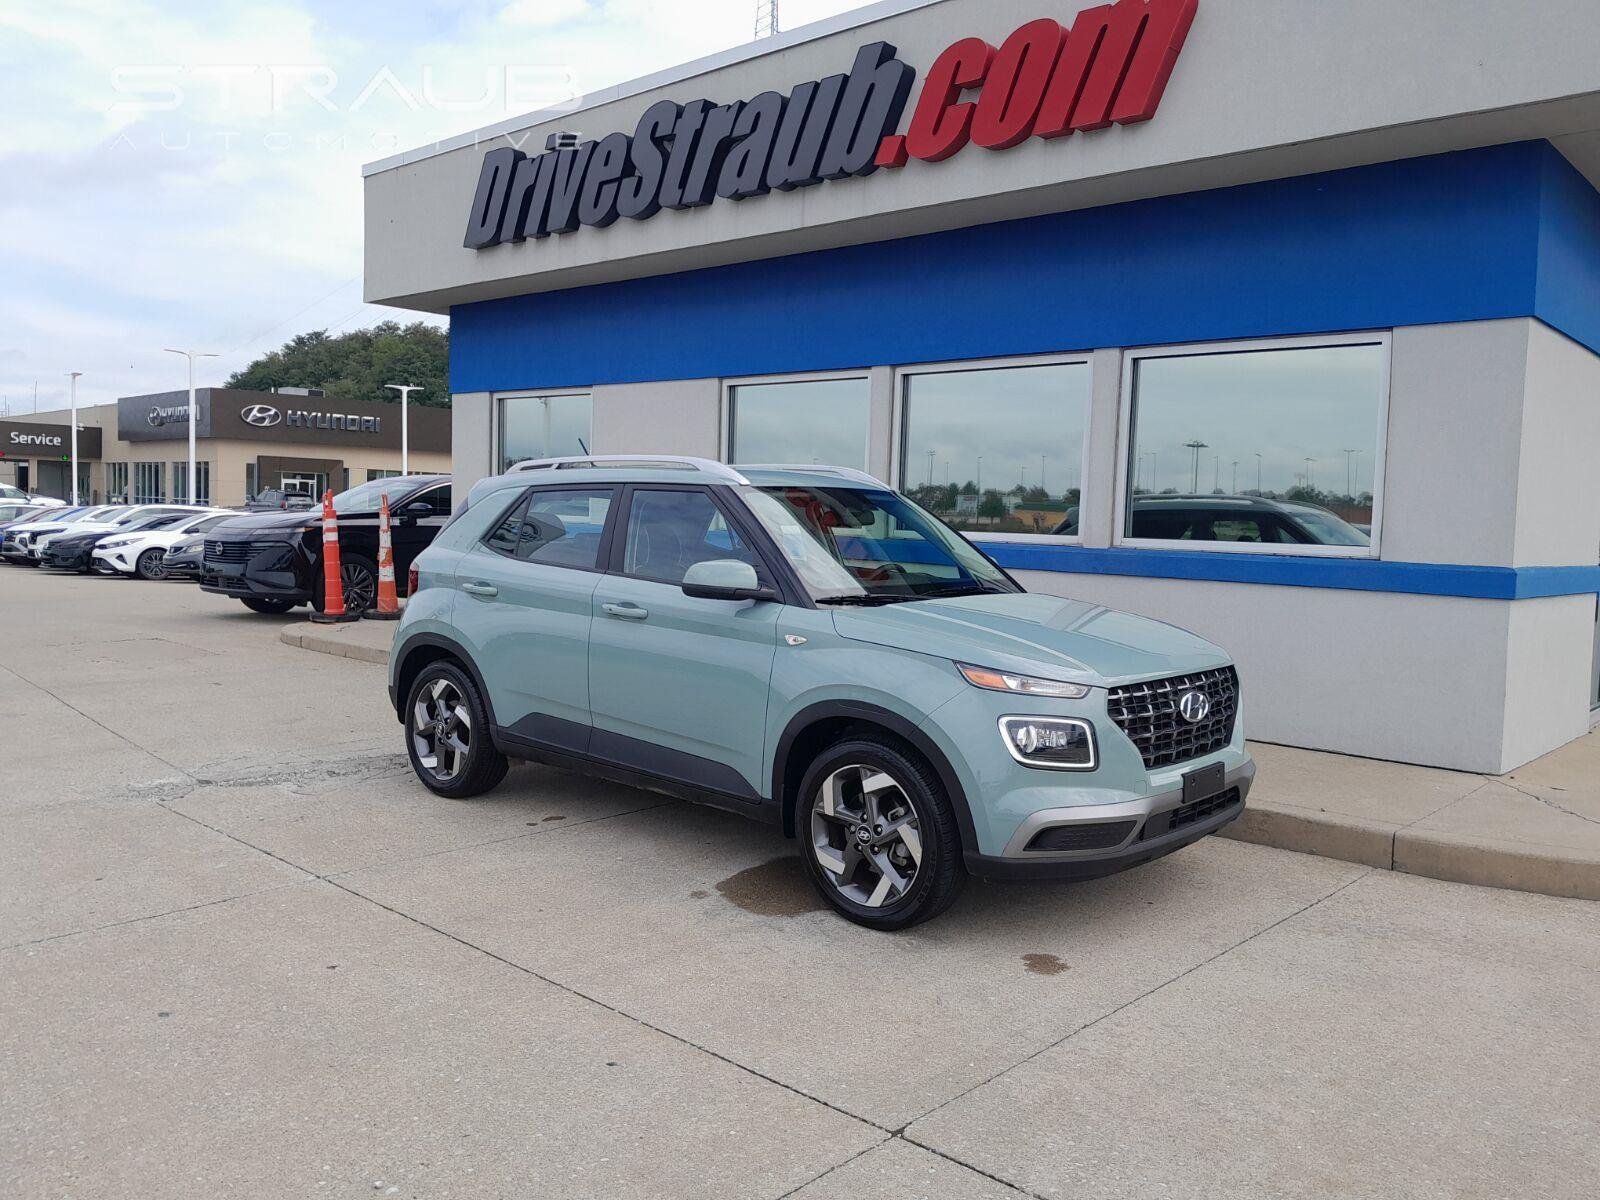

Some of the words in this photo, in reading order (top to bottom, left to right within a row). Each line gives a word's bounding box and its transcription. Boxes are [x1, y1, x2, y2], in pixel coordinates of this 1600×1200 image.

[464, 0, 1199, 249] DriveStraub.com
[286, 409, 382, 434] HYUNDAI
[10, 431, 62, 446] Service
